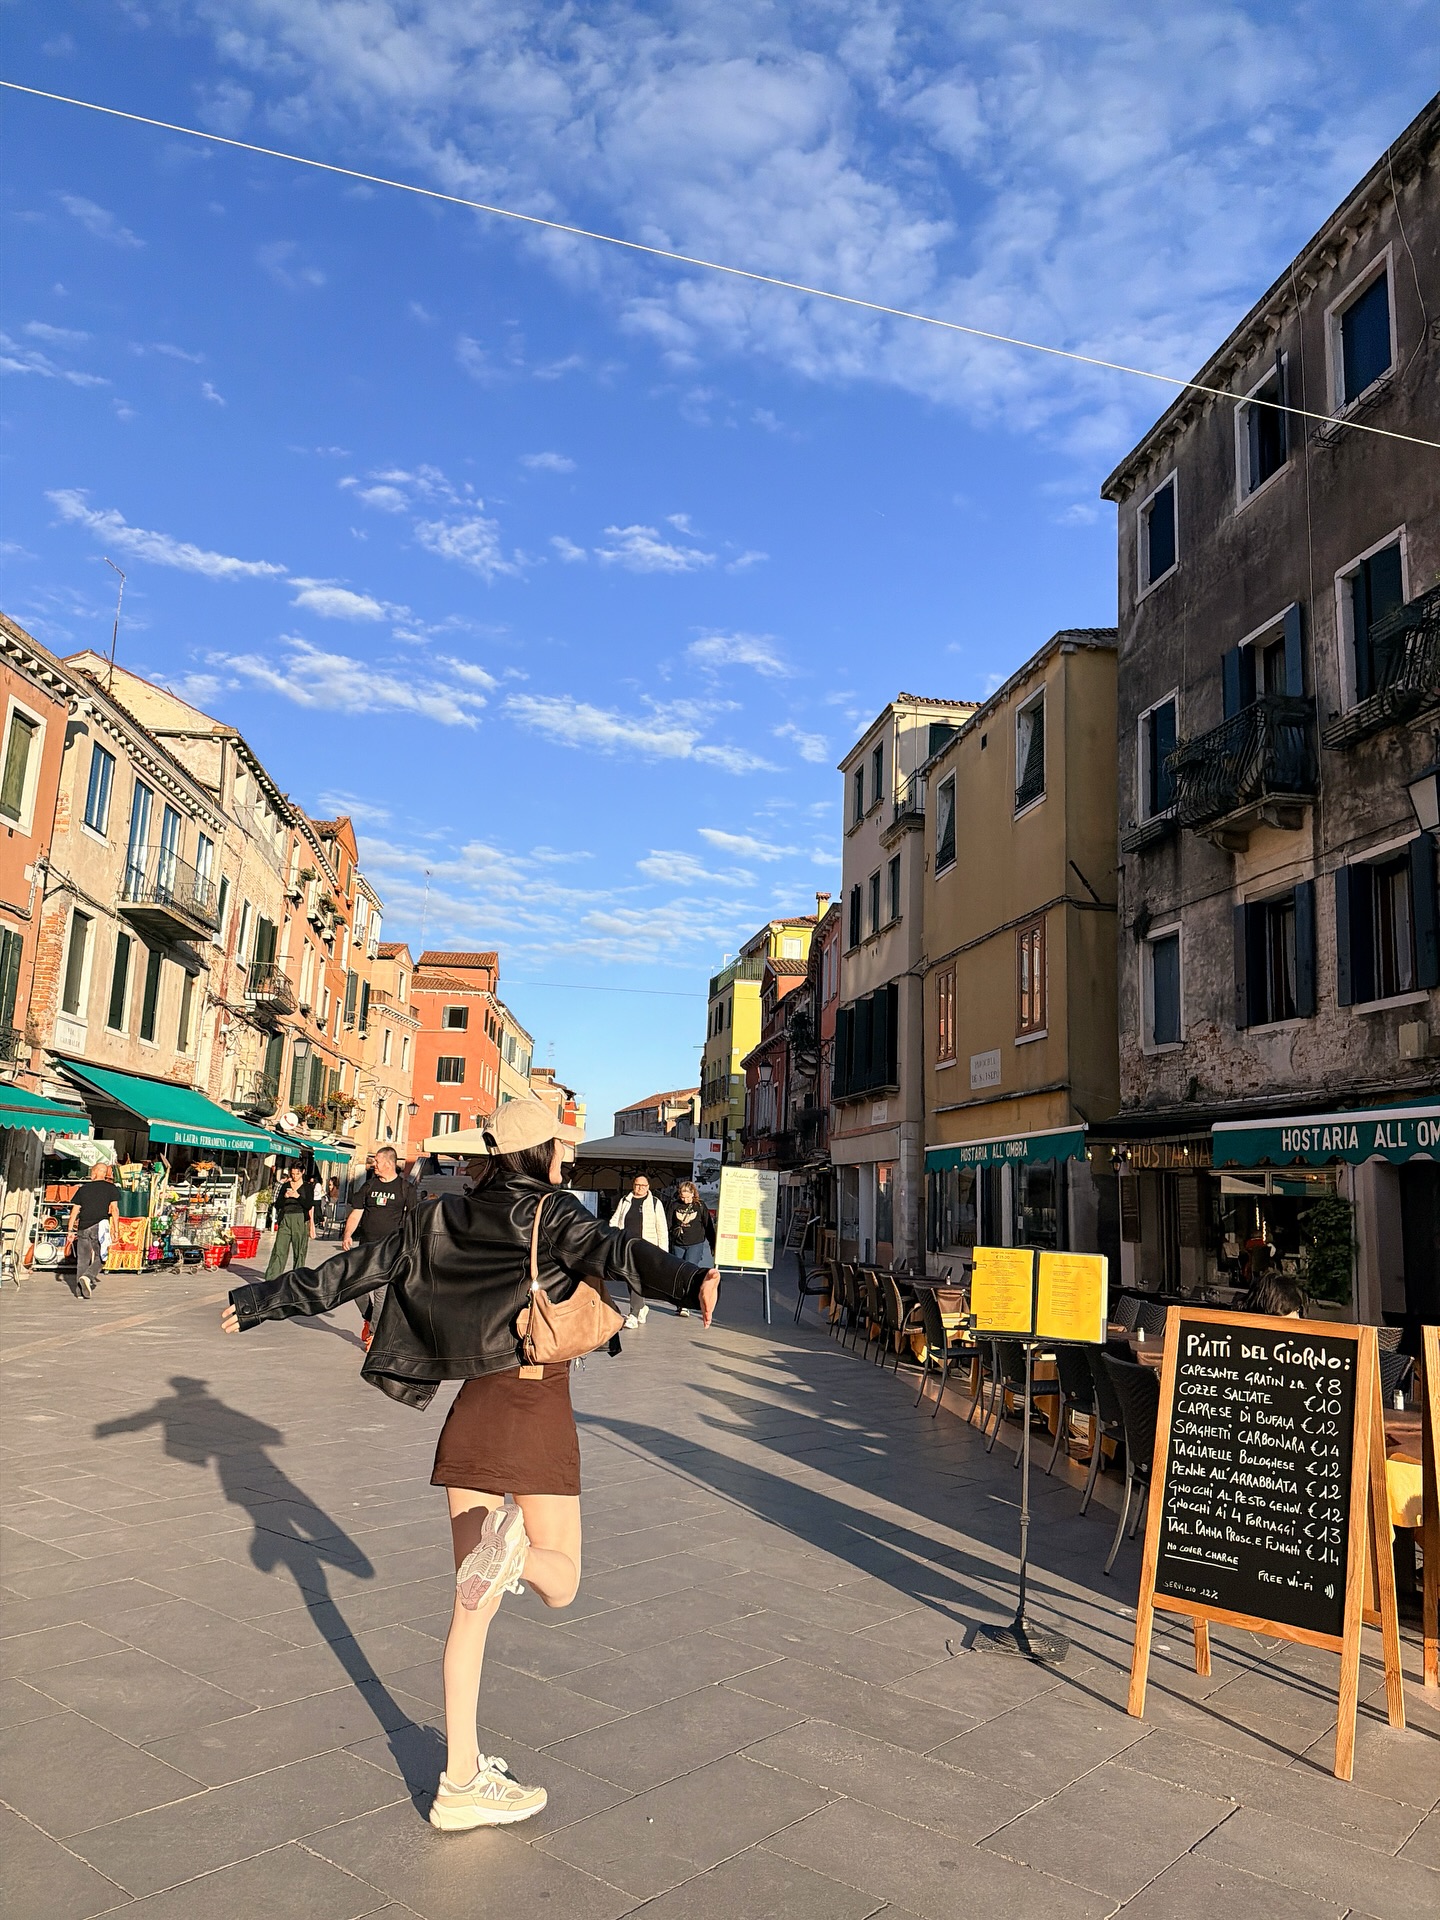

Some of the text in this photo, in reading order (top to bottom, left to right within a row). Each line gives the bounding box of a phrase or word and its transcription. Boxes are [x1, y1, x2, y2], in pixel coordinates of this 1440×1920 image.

[174, 1132, 182, 1143] DA
[182, 1133, 199, 1145] LAURA
[1282, 1125, 1359, 1152] HOSTARIA
[960, 1146, 988, 1162] HOSTARIA
[371, 1191, 396, 1200] ITALIA
[1241, 1344, 1268, 1360] DEL
[1180, 1363, 1239, 1381] CAPESANTE
[1178, 1382, 1342, 1415] COZZE SALTATE €10
[1177, 1400, 1232, 1419] CAPRESE
[1256, 1410, 1295, 1430] BUFALA
[1300, 1417, 1339, 1436] €12
[1238, 1430, 1306, 1454] CARBONARA
[1310, 1440, 1339, 1457] €14
[1172, 1460, 1206, 1477] PENNE
[1239, 1449, 1295, 1471] BOLOGNESE
[1217, 1489, 1233, 1501] AL
[1235, 1490, 1266, 1507] PESTO
[1231, 1508, 1241, 1523] 4
[1166, 1516, 1193, 1535] TAGL.
[1195, 1519, 1223, 1539] PANNA
[1179, 1545, 1202, 1556] COVER
[1205, 1550, 1239, 1565] CHARGE
[1258, 1570, 1283, 1585] FREE
[1199, 1588, 1219, 1600] 12%
